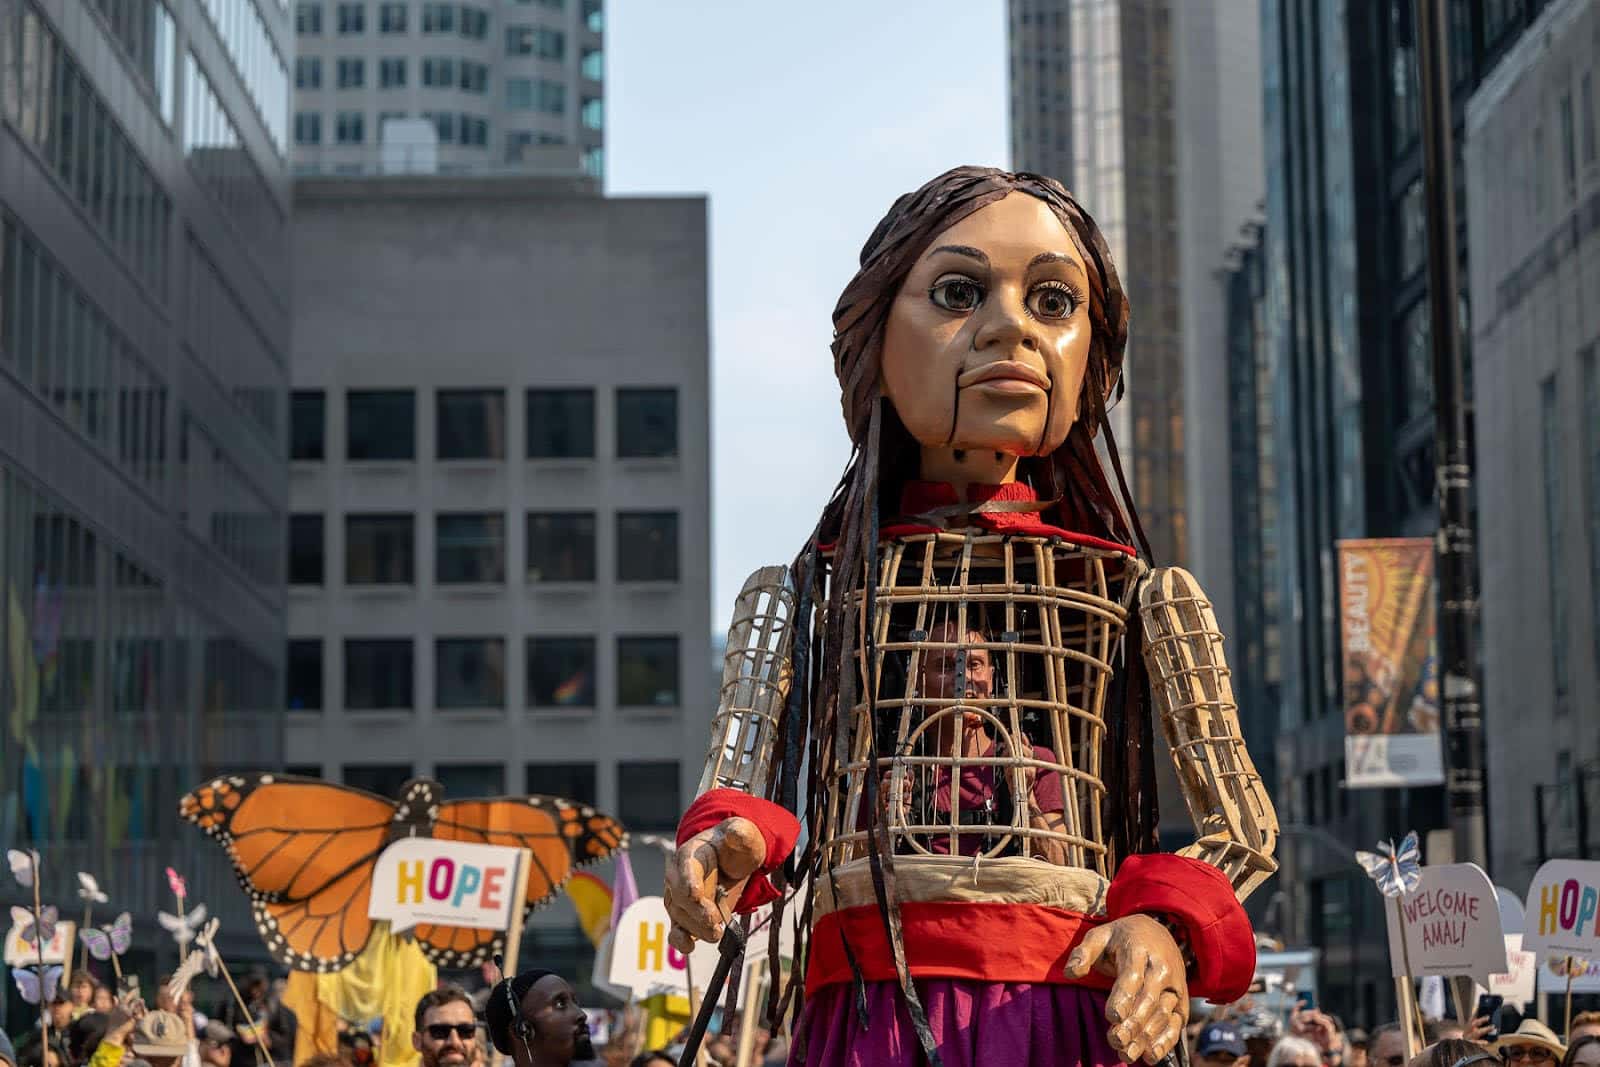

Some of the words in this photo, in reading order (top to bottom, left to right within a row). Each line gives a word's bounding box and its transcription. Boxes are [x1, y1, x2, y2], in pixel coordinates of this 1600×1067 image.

[1344, 552, 1371, 652] BEAUTY
[397, 857, 506, 910] HOPE
[1403, 888, 1480, 924] WELCOME
[1423, 920, 1466, 951] AMAL!
